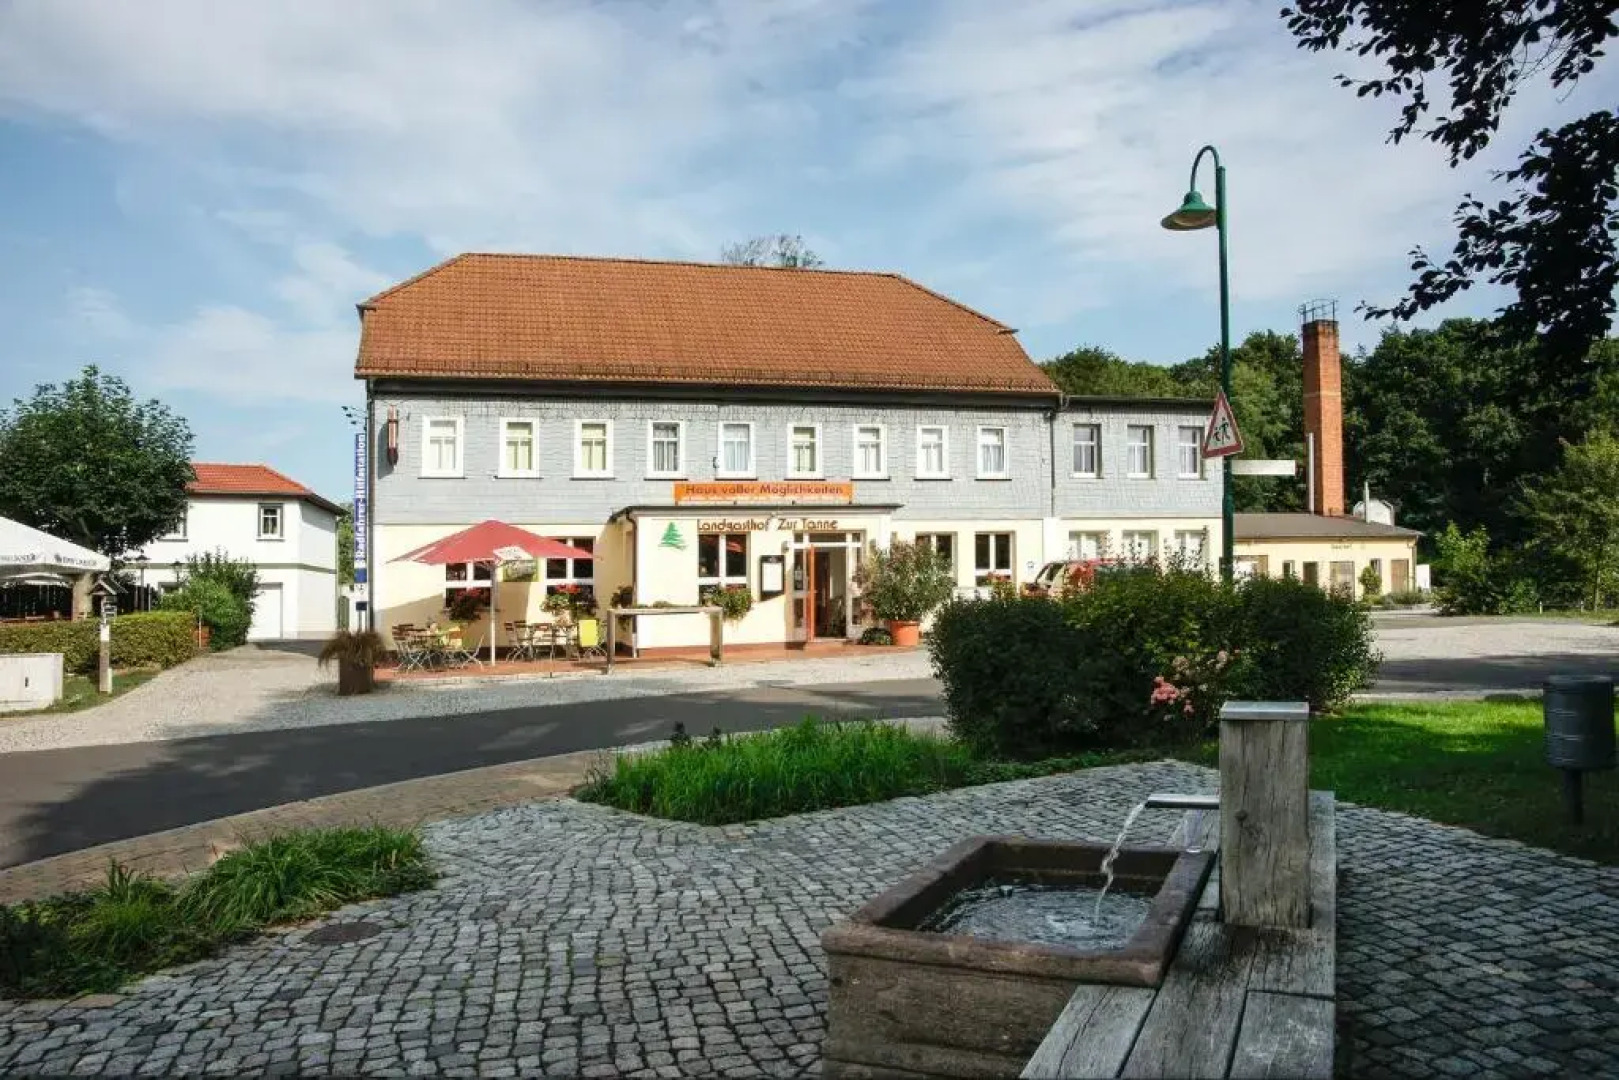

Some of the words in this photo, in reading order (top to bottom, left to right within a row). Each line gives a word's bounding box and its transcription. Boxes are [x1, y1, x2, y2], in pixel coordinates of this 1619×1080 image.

[685, 484, 717, 494] Haus
[722, 483, 755, 494] voller
[759, 483, 844, 497] Möglichkeiten
[696, 518, 771, 531] Landgasthof
[777, 518, 798, 531] Zur
[801, 518, 839, 530] Tanne
